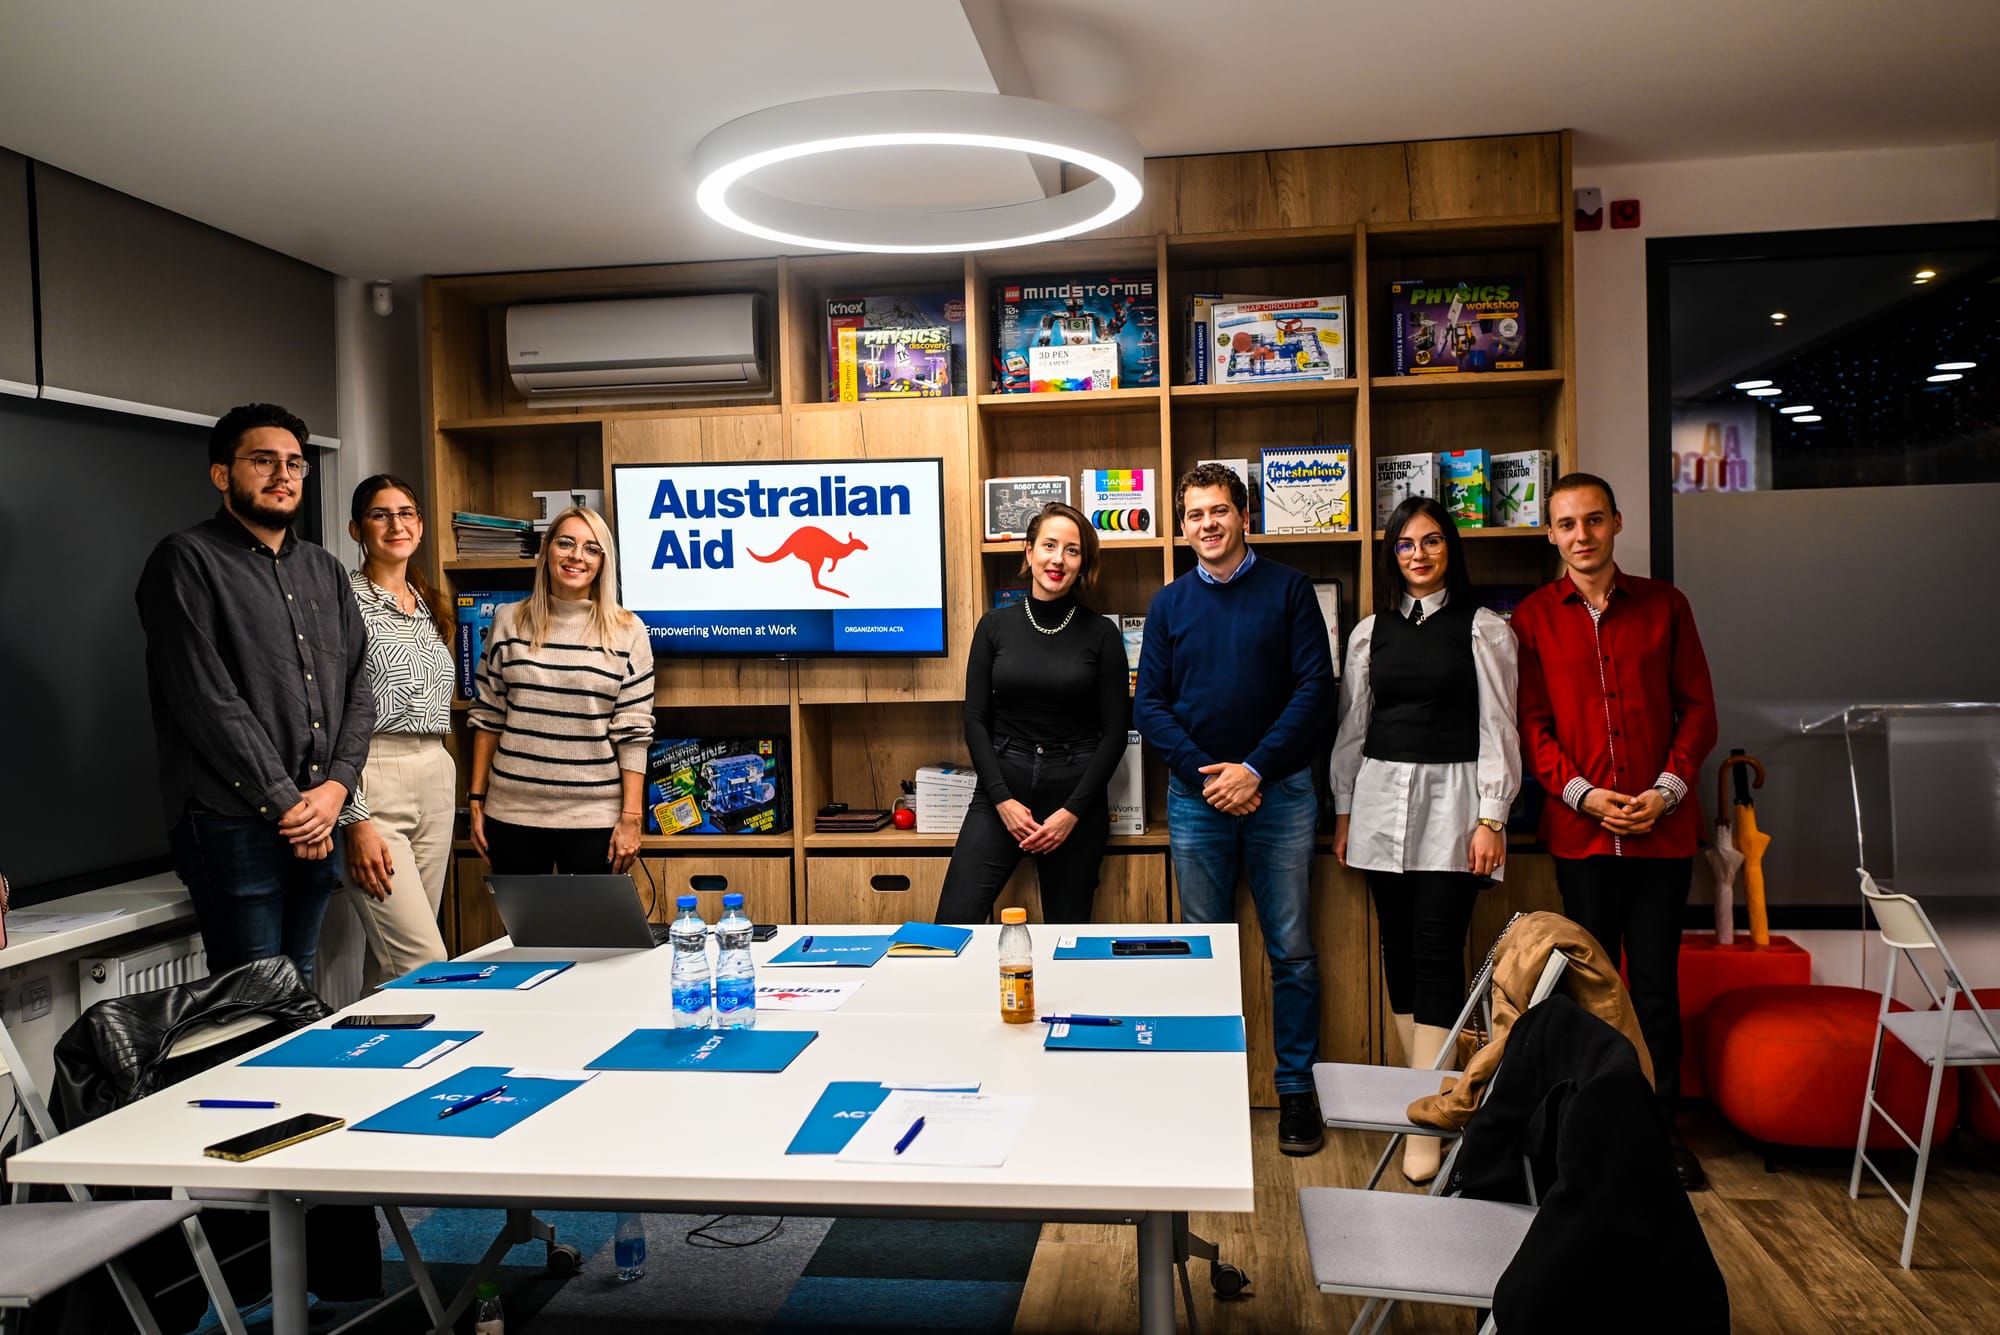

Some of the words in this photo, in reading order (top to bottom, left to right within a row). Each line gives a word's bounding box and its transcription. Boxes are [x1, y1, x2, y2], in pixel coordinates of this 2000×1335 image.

[1411, 285, 1511, 304] PHYSICS
[1262, 301, 1303, 312] CIRCUITS
[1466, 301, 1519, 312] workshop
[864, 328, 942, 345] PHYSICS
[909, 342, 947, 350] discovery
[1039, 351, 1050, 359] 3D
[1052, 350, 1069, 359] PEN
[1377, 461, 1412, 472] WEATHER
[1492, 459, 1524, 470] WINDMILL
[1269, 465, 1342, 479] Telestrations
[1377, 470, 1408, 481] STATION
[1492, 467, 1530, 480] GENERATOR
[649, 475, 911, 519] Australian
[1097, 493, 1109, 501] 3D
[651, 529, 735, 570] Aid
[645, 625, 710, 638] Empowering
[711, 625, 752, 636] Women
[755, 626, 766, 635] at
[768, 624, 797, 636] Work
[670, 743, 727, 772] ENGINE
[681, 996, 704, 1006] rosa
[430, 1093, 476, 1102] ACT
